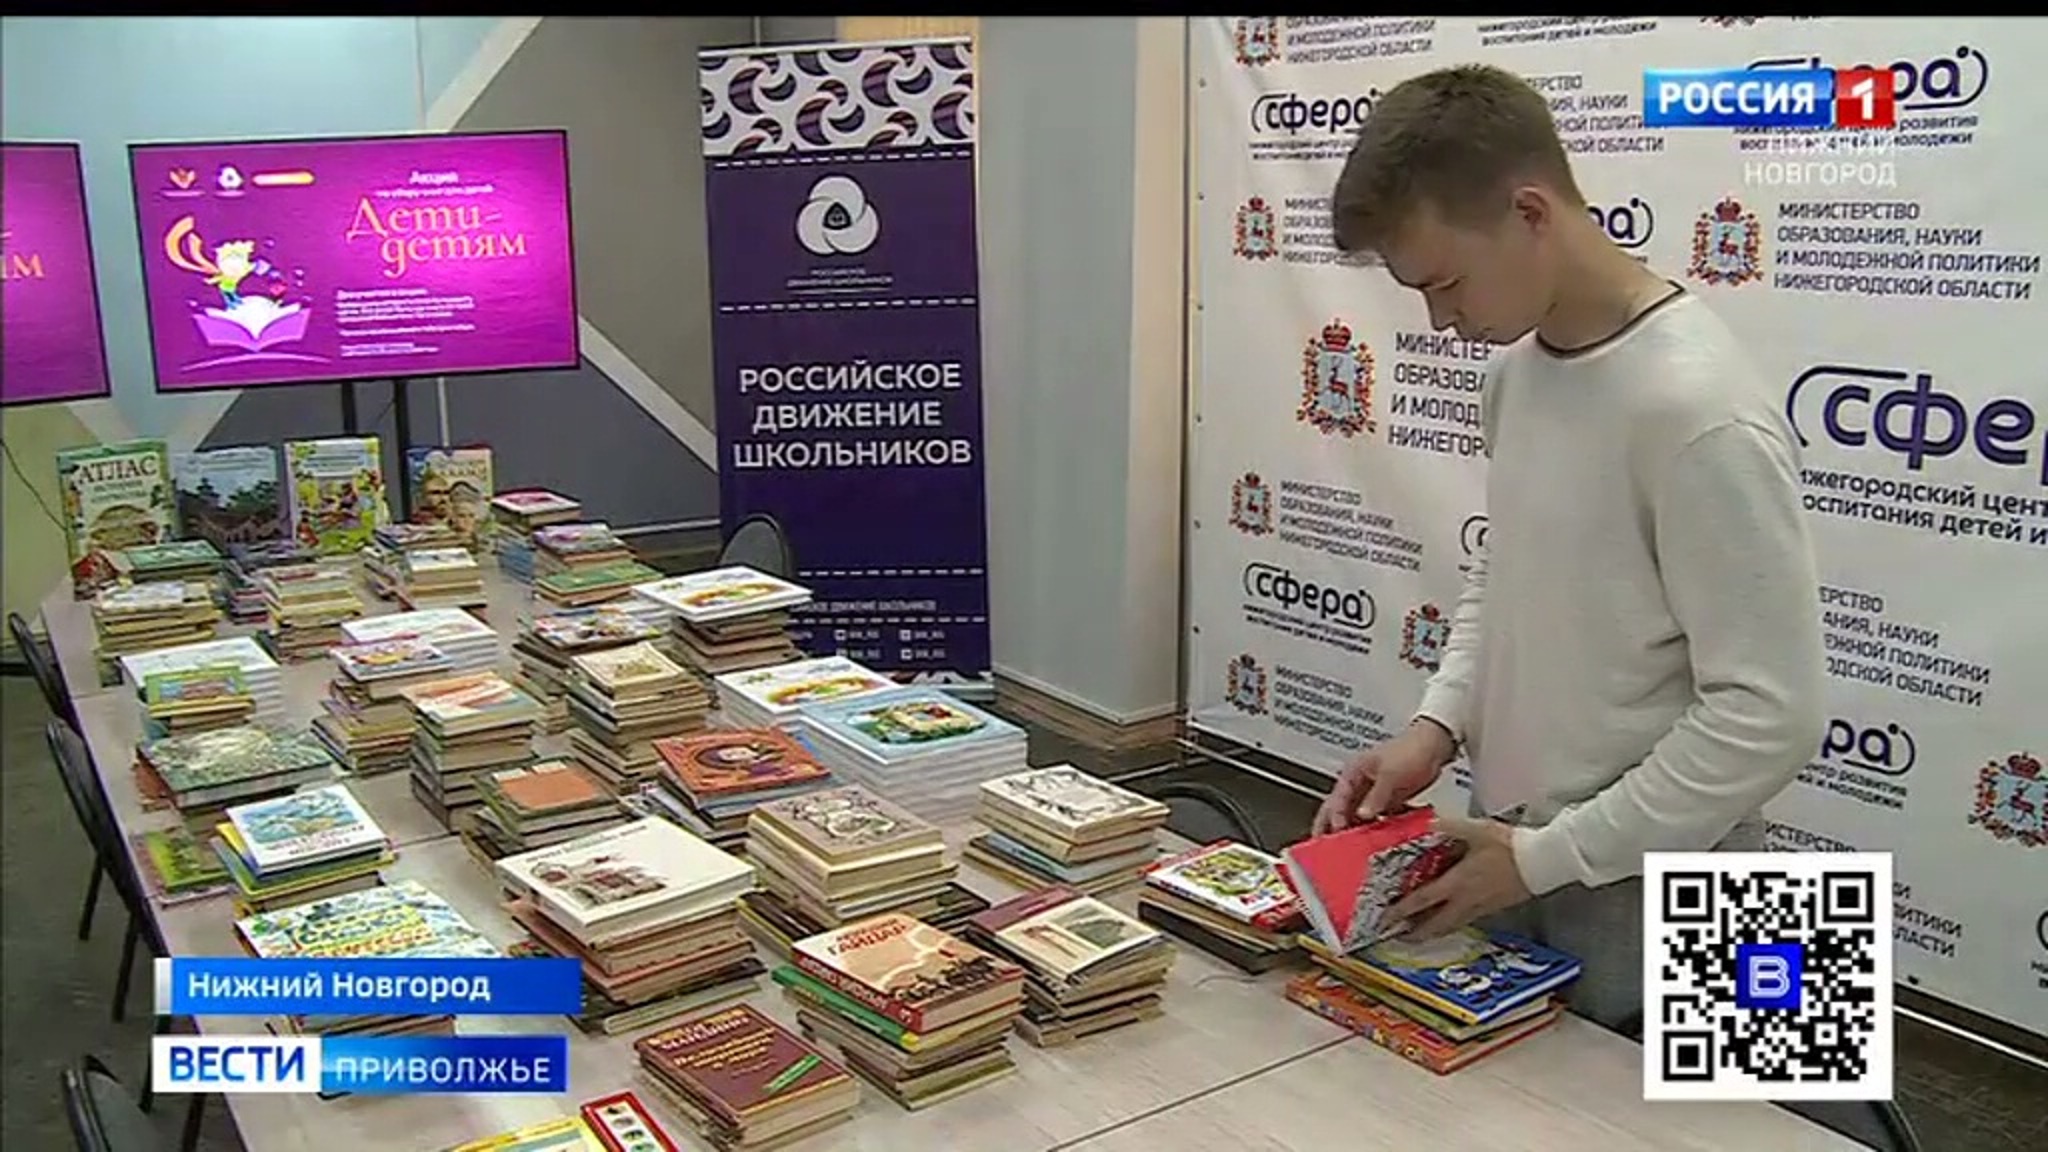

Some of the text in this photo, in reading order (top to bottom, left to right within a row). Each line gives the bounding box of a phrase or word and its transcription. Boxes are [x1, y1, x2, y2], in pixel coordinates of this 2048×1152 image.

[1778, 202, 1921, 220] МИНИСТЕРСТВО
[1776, 226, 1983, 247] ОБРАЗОВАНИЯ, НАУКИ
[380, 233, 527, 278] детям
[1775, 249, 2041, 273] И МОЛОДЕЖНОЙ ПОЛИТИКИ
[1773, 272, 2032, 299] НИЖЕГОРОДСКОЙ ОБЛАСТИ
[1395, 332, 1491, 361] МИНИСТЕР
[739, 359, 962, 392] РОССИЙСКОЕ
[752, 402, 942, 434] ДВИЖЕНИЕ
[1390, 393, 1480, 430] И МОЛОД
[1820, 372, 2048, 487] сфе
[78, 455, 158, 483] АТЛАС
[733, 439, 972, 468] ШКОЛЬНИКОВ
[1799, 468, 1976, 510] ижегородский
[1802, 493, 1935, 529] оспитания
[1939, 514, 2022, 542] детей
[1255, 569, 1366, 623] сфера
[1878, 621, 1940, 649] НАУКИ
[1888, 646, 1991, 685] ПОЛИТИКИ
[1896, 674, 1983, 707] ОБЛАСТИ
